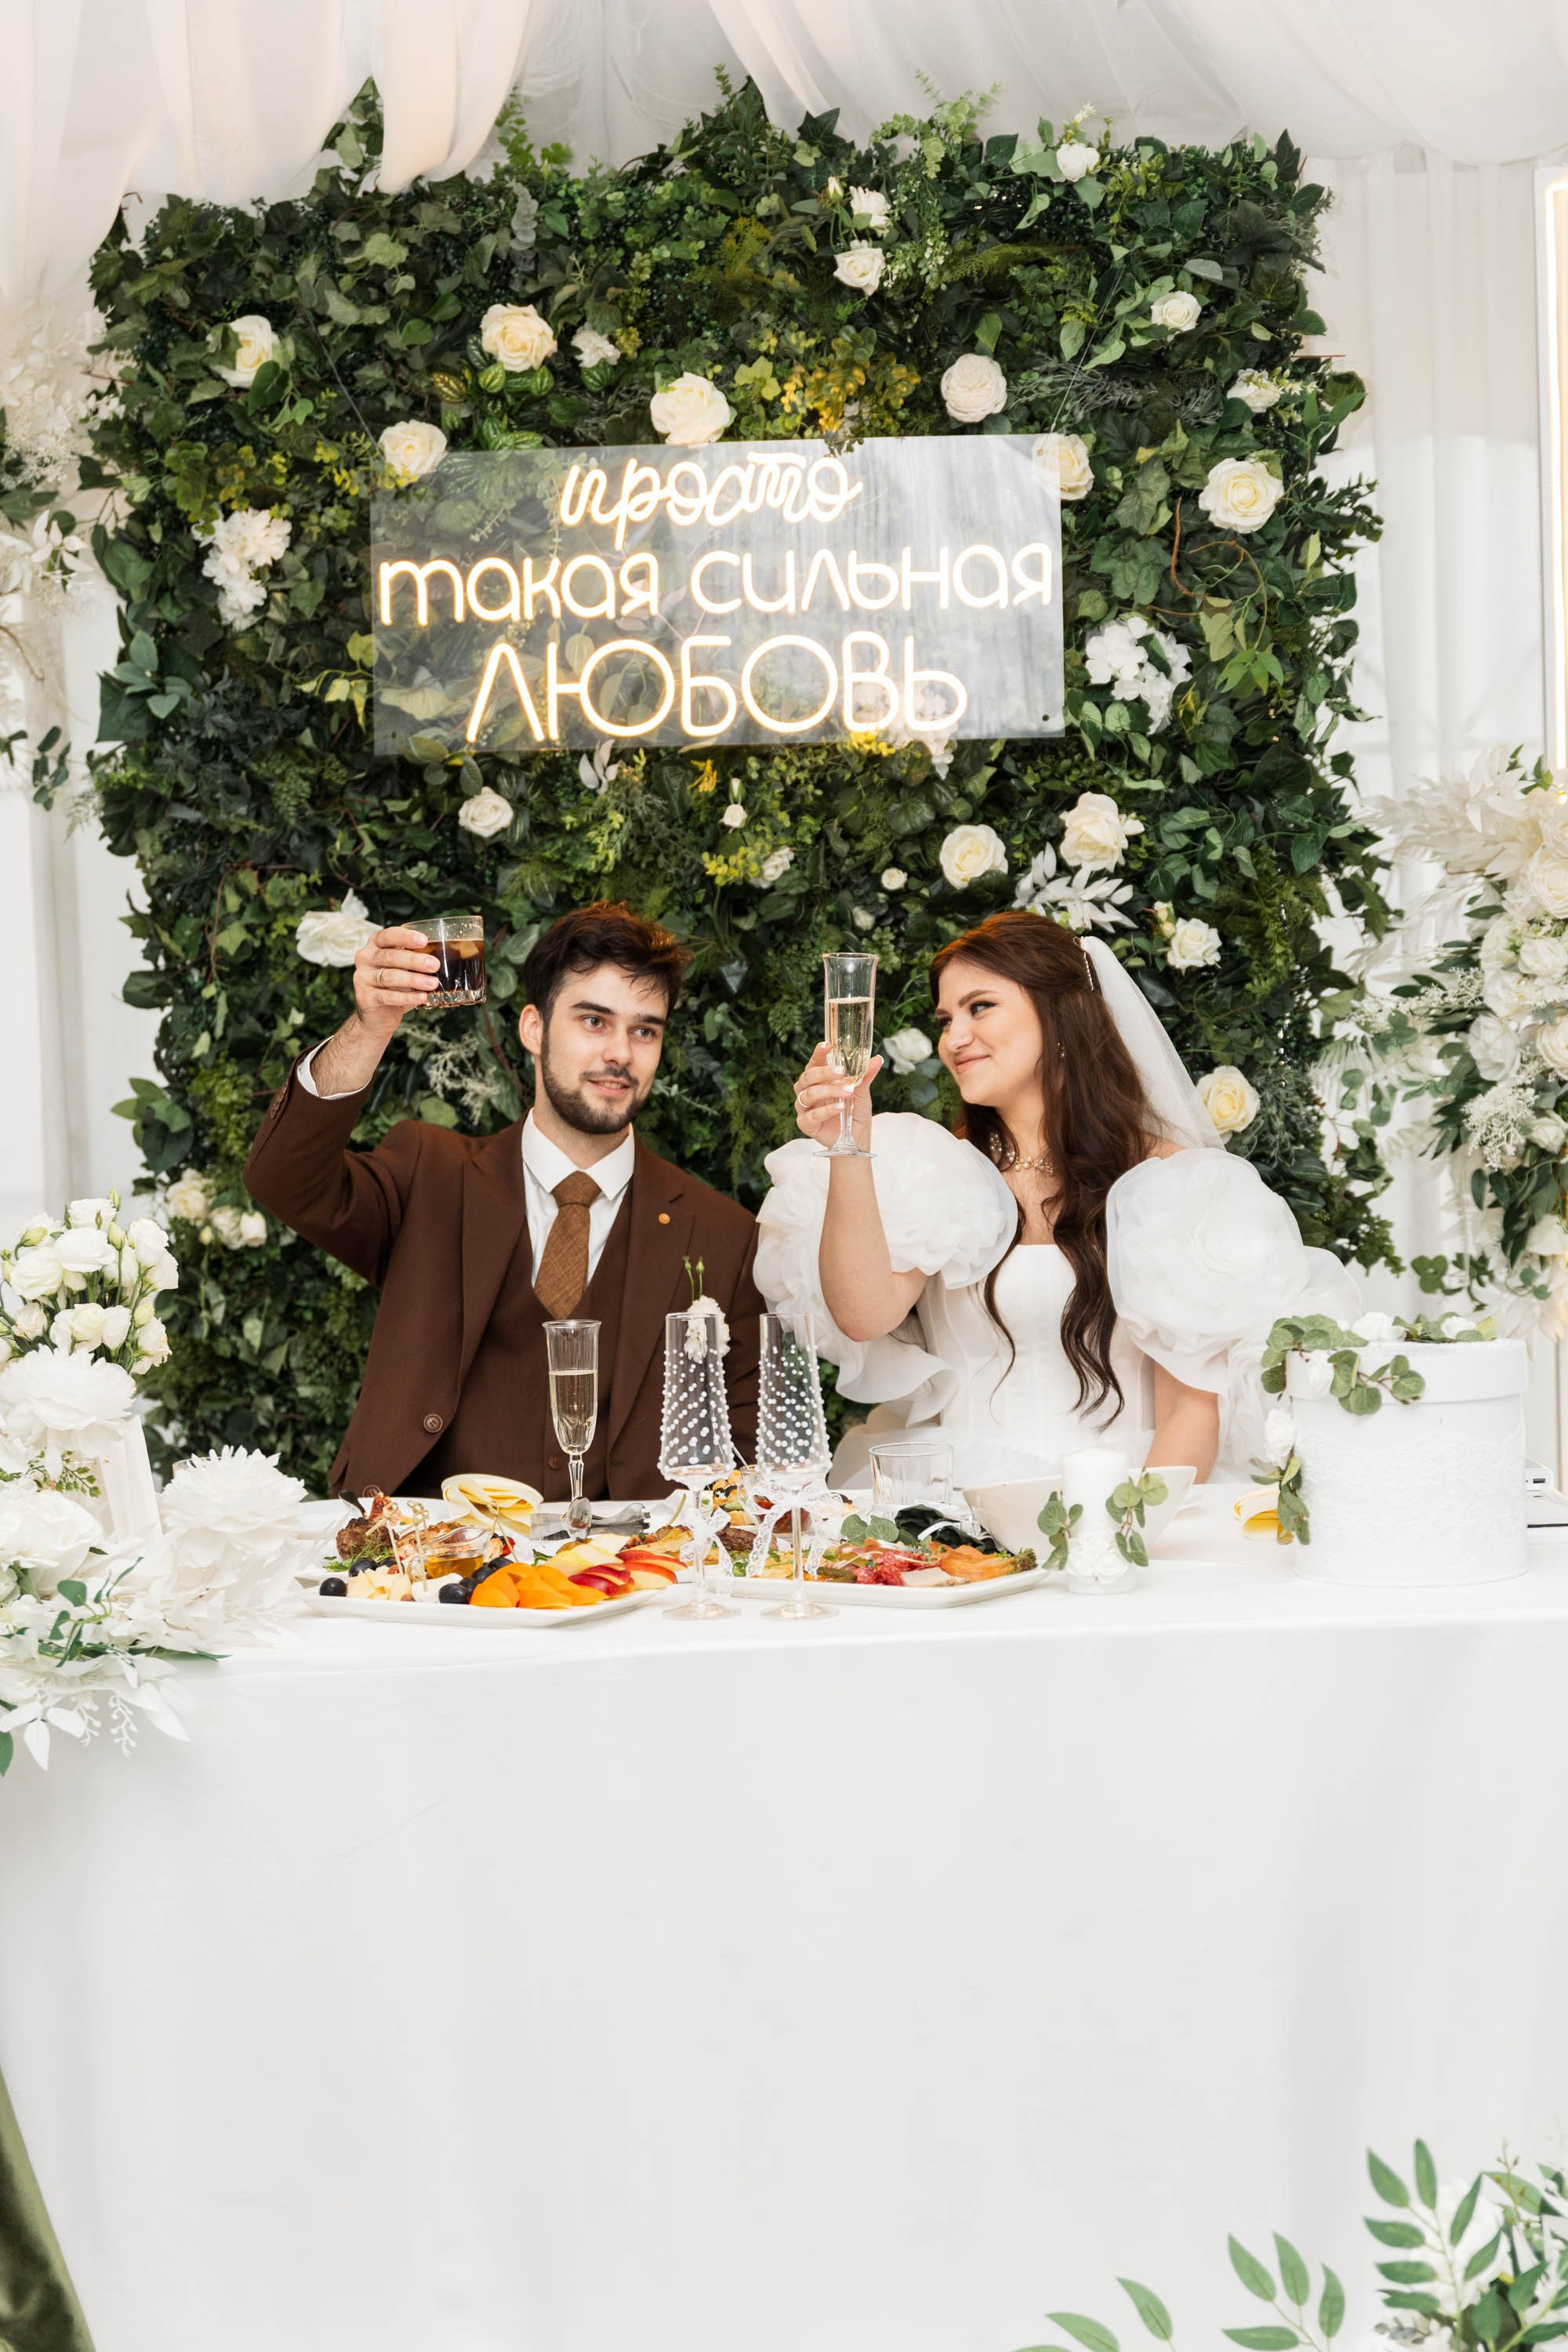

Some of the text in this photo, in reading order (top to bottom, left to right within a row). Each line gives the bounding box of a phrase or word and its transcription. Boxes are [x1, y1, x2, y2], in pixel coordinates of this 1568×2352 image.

[560, 452, 862, 550] просто
[379, 542, 1053, 626] такая сильная
[466, 631, 968, 742] ЛЮБОВЬ
